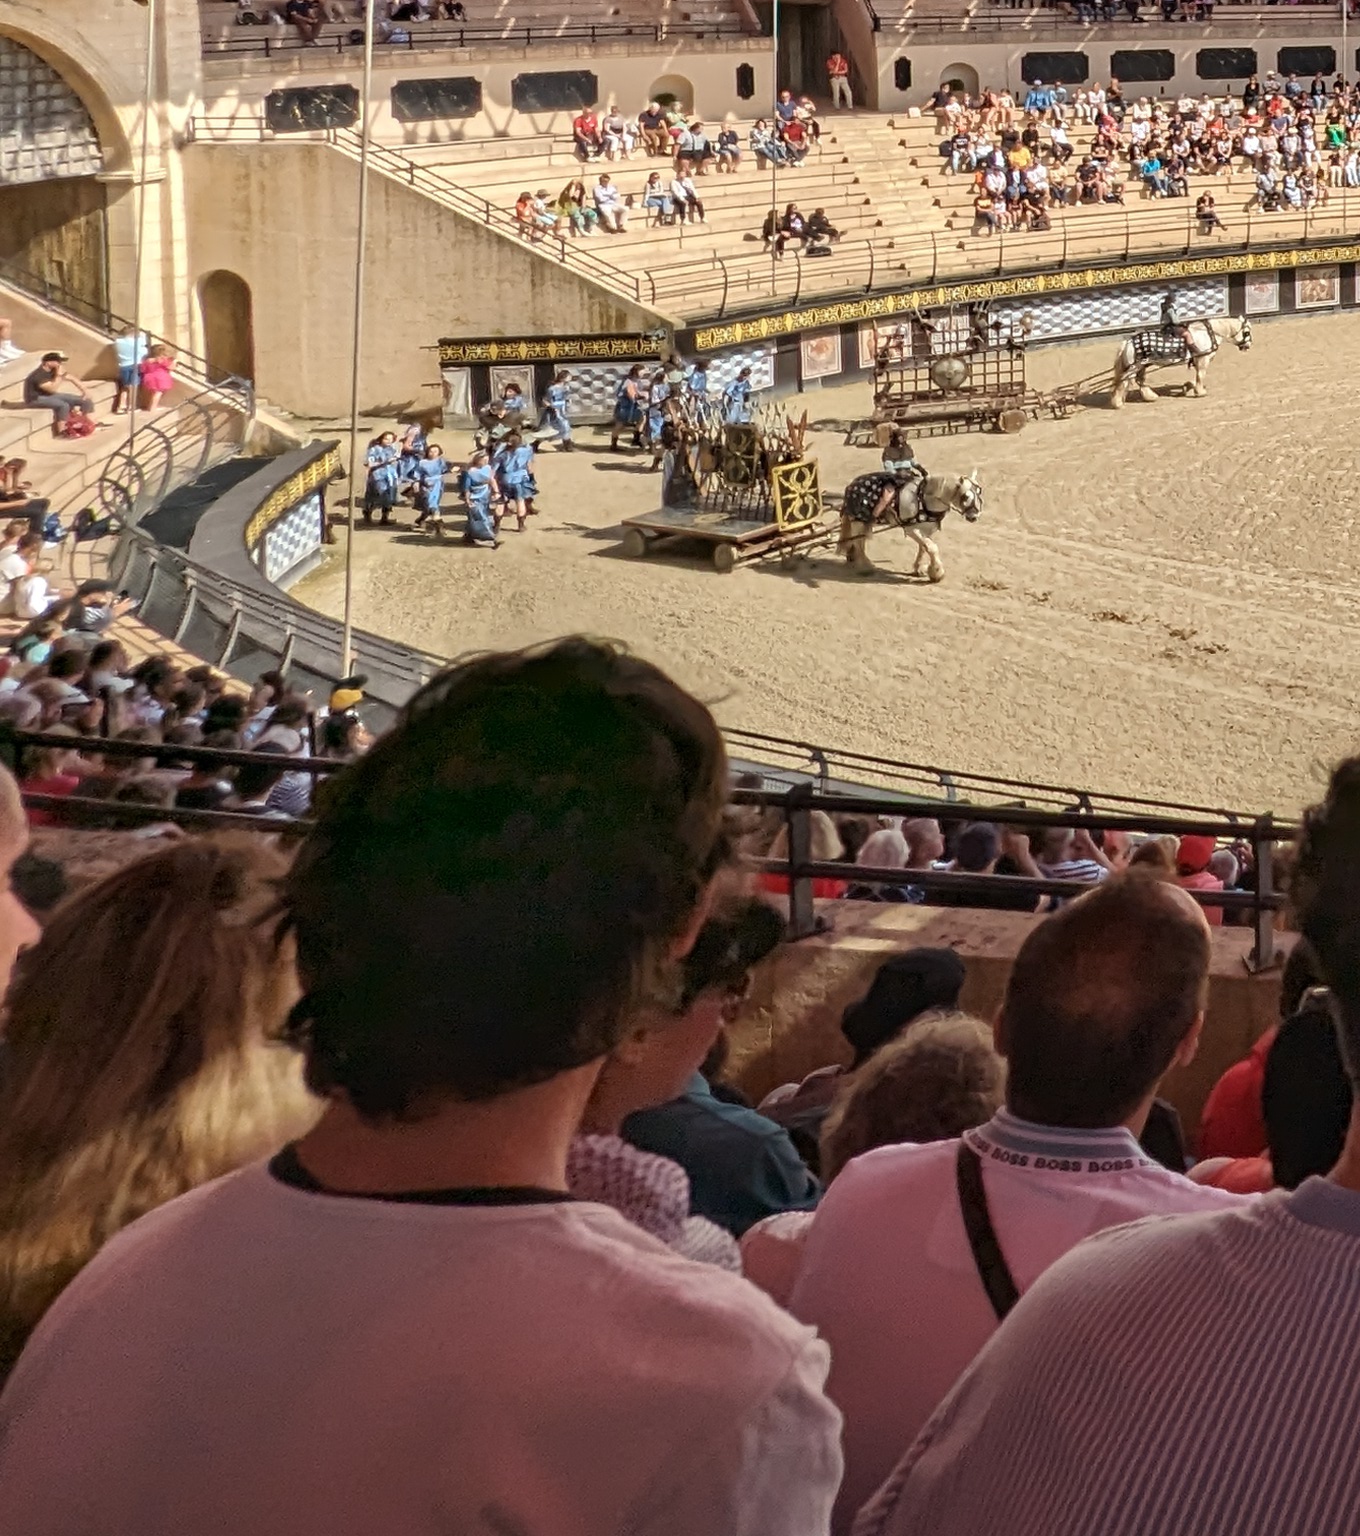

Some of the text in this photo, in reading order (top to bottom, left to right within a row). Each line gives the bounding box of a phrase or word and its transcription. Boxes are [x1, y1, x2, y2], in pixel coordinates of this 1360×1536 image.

[991, 1147, 1029, 1167] BOSS
[1034, 1157, 1082, 1172] BOSS
[1088, 1159, 1134, 1173] BOSS
